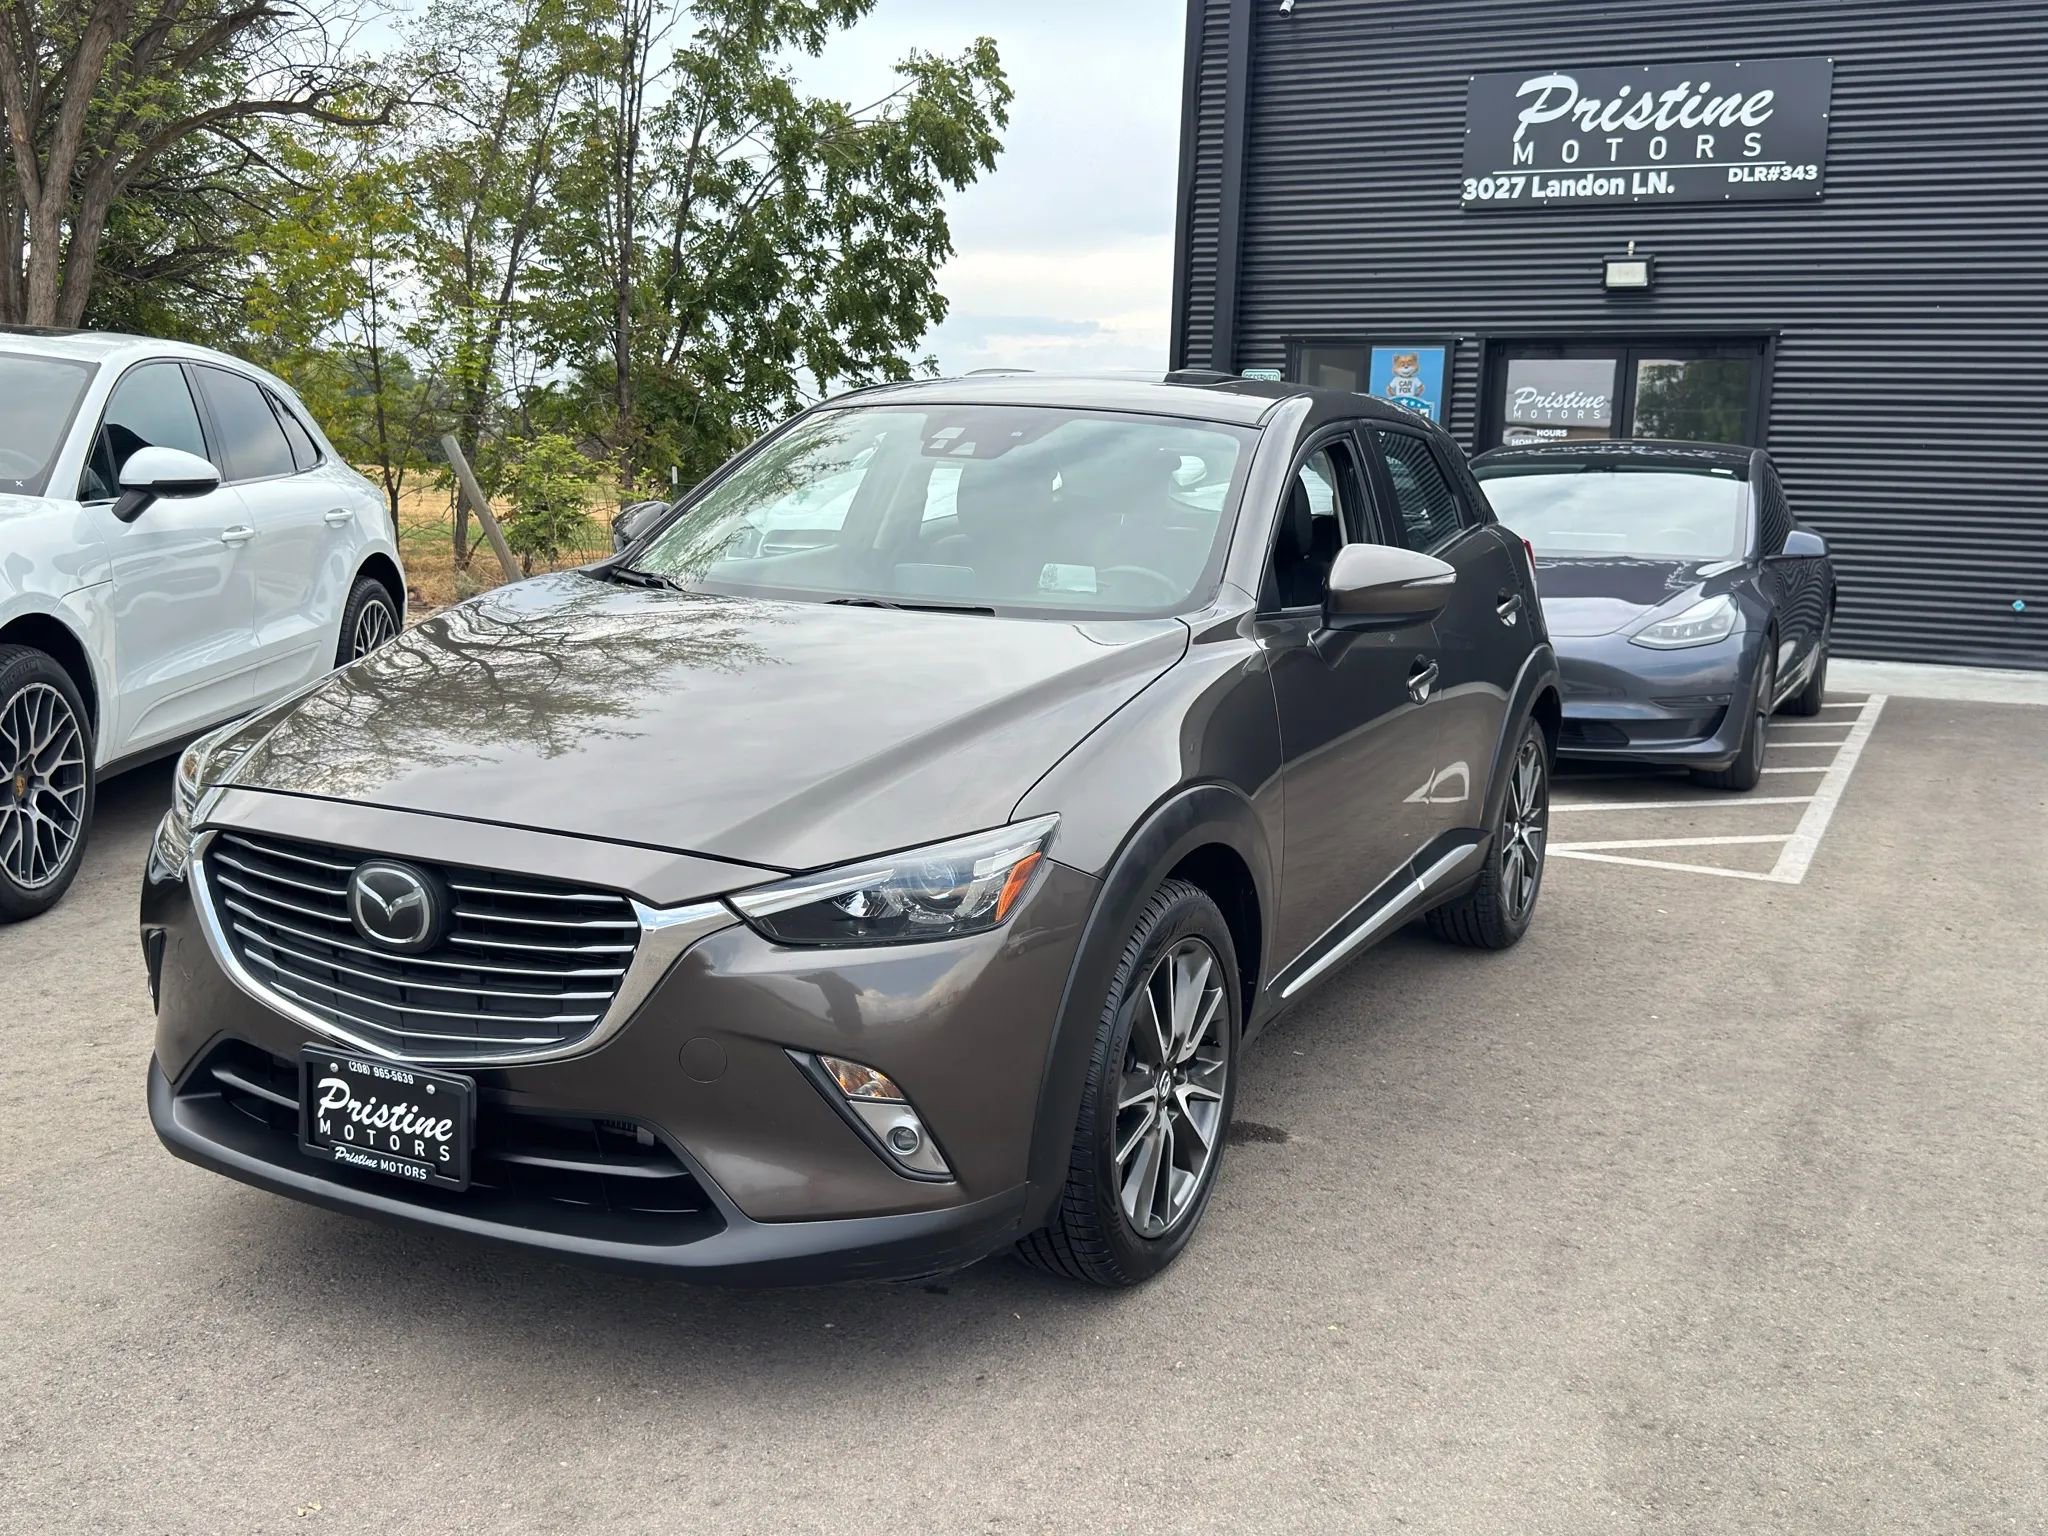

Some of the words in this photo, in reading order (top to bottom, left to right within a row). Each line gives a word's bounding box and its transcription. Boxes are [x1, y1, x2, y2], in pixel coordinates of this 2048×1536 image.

[1513, 74, 1775, 143] Pristine
[1512, 132, 1762, 166] MOTORS
[1462, 177, 1525, 201] 3027
[1531, 174, 1625, 199] Landon
[1631, 170, 1676, 195] LN.
[1727, 164, 1819, 184] DLR#343
[1513, 387, 1605, 410] Pristine
[1513, 410, 1601, 419] MOTORS
[1536, 429, 1568, 437] HOURS
[348, 1060, 371, 1076] (208)
[373, 1067, 414, 1085] 965-5639
[317, 1077, 453, 1142] Pristine
[319, 1117, 451, 1162] MOTORS
[334, 1146, 378, 1169] Pristine
[380, 1159, 427, 1180] MOTORS
